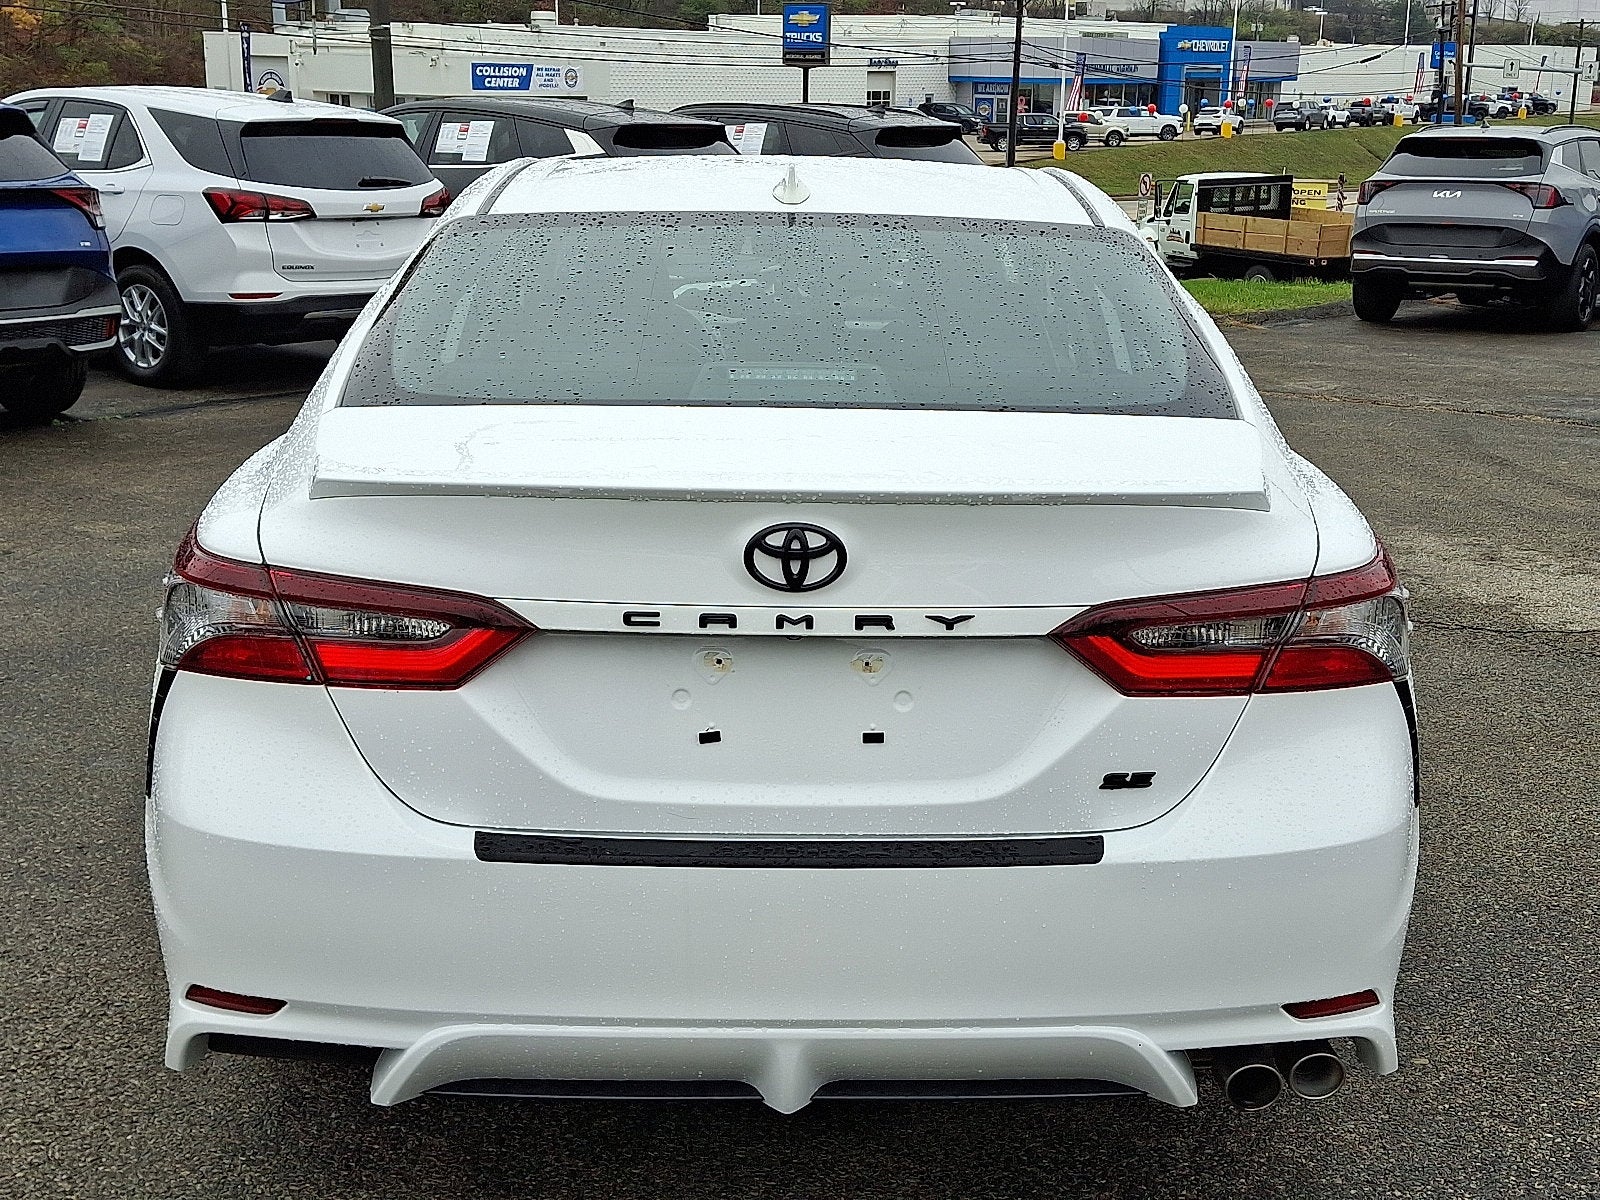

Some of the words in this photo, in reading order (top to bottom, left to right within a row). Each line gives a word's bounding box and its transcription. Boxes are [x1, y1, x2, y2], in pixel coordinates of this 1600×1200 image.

[785, 32, 823, 43] TRUCKS
[1192, 40, 1230, 52] CHEVROLET
[475, 66, 527, 77] COLLISION
[484, 77, 520, 88] CENTER
[622, 611, 976, 631] CAMRY
[1099, 771, 1157, 791] SE
